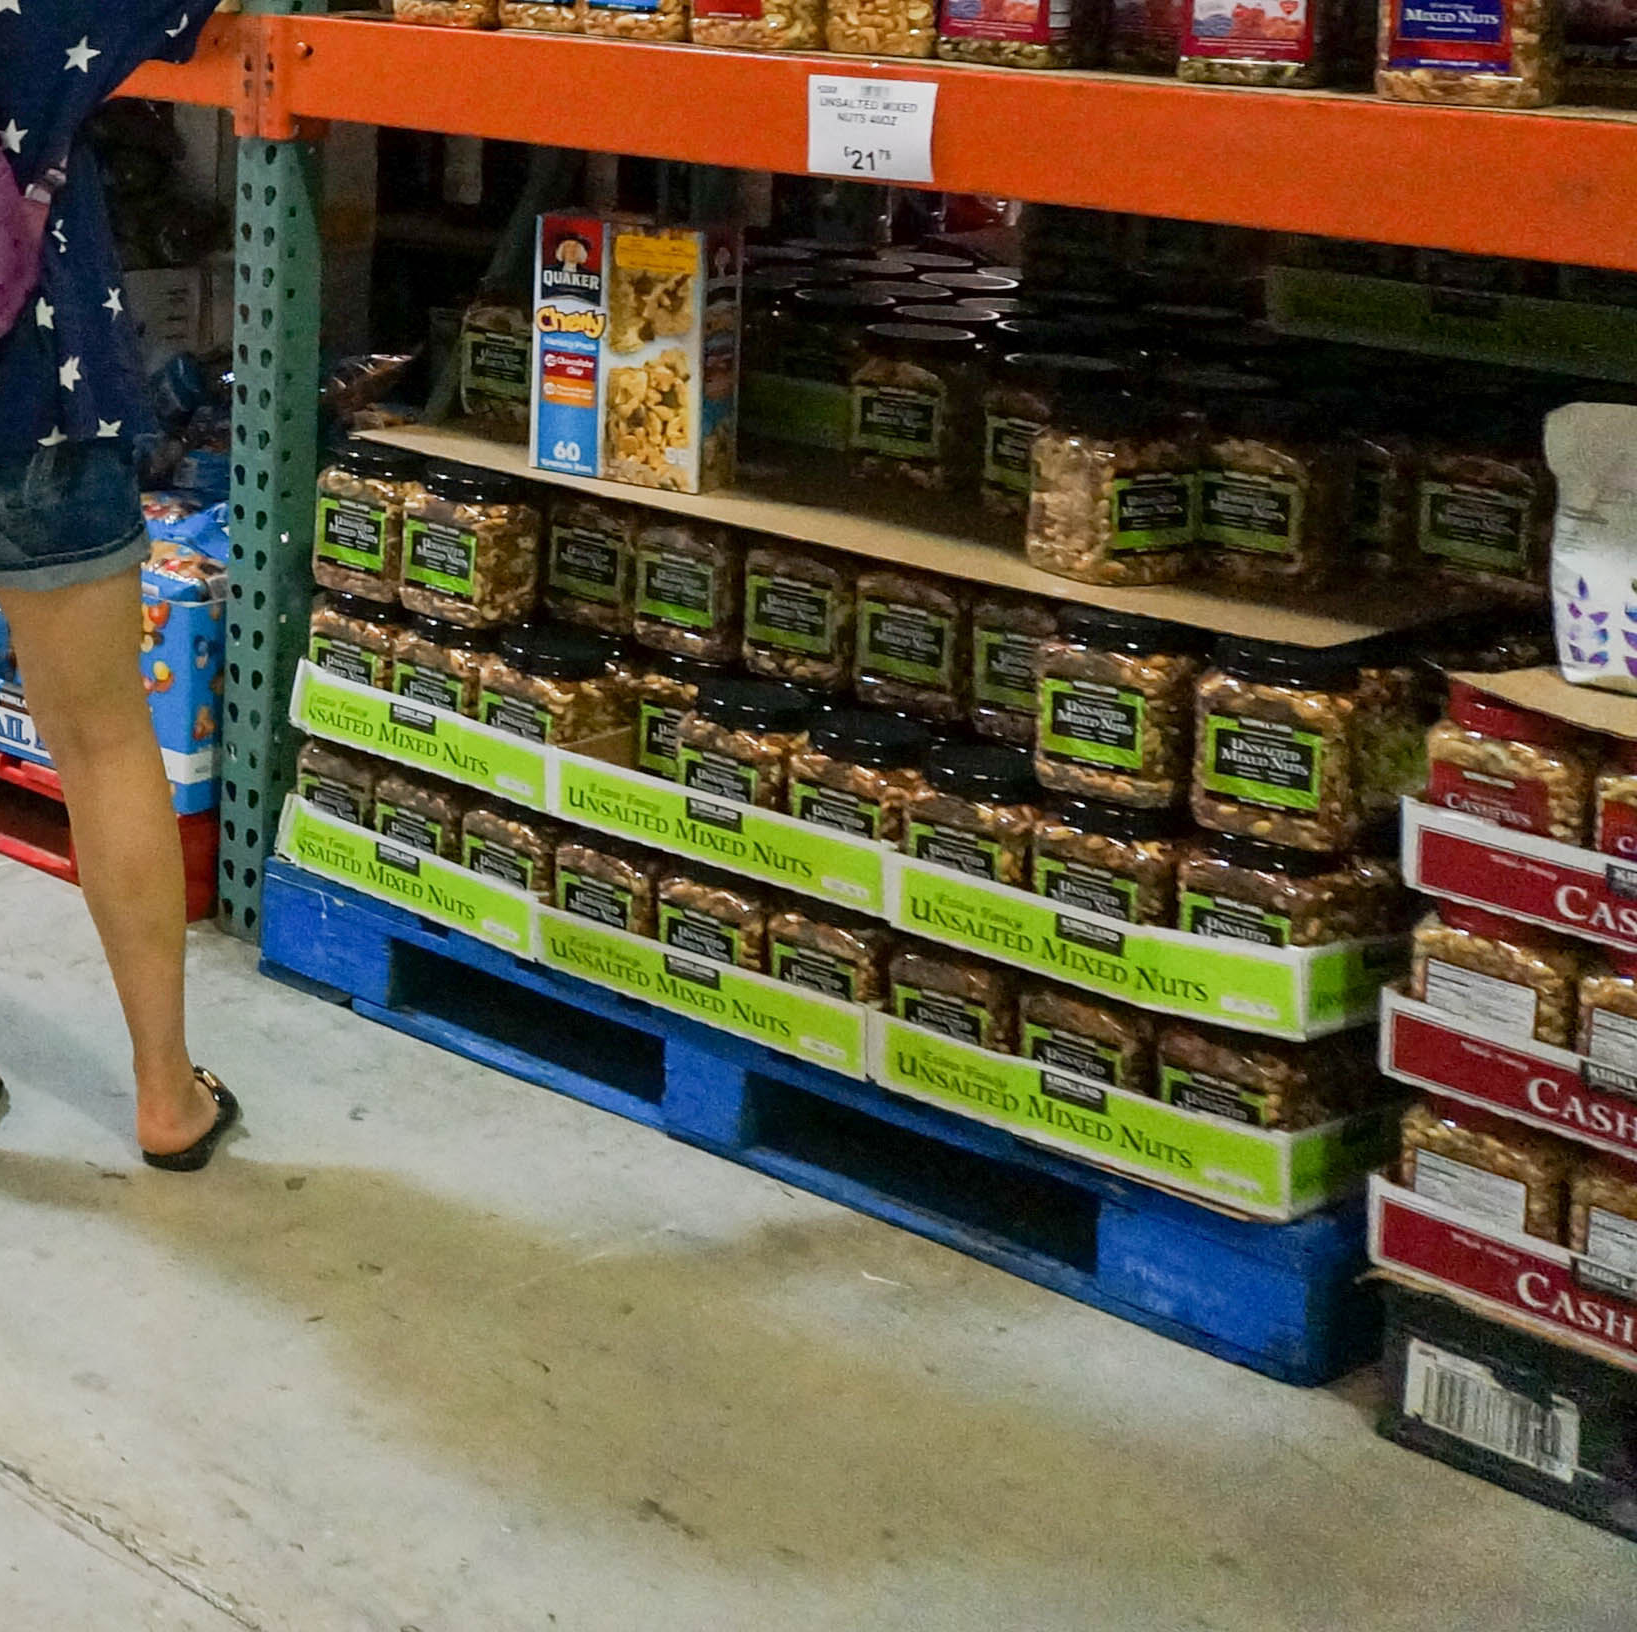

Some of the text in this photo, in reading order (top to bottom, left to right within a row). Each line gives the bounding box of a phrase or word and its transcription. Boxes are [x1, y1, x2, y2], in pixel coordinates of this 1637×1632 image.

[543, 270, 600, 290] QUAKER
[536, 305, 606, 340] Chewy
[553, 440, 581, 461] 60
[378, 723, 438, 757] MIXED
[442, 742, 489, 777] NUTS
[568, 786, 813, 878] UNSALTED MIXED NUTS
[365, 863, 424, 898] MIXED
[429, 885, 476, 920] NUTS
[909, 896, 1208, 1003] UNSALTED MIXED NUTS
[550, 936, 791, 1038] UNSALTED MIXED NUTS
[897, 1052, 1192, 1170] UNSALTED MIXED NUTS
